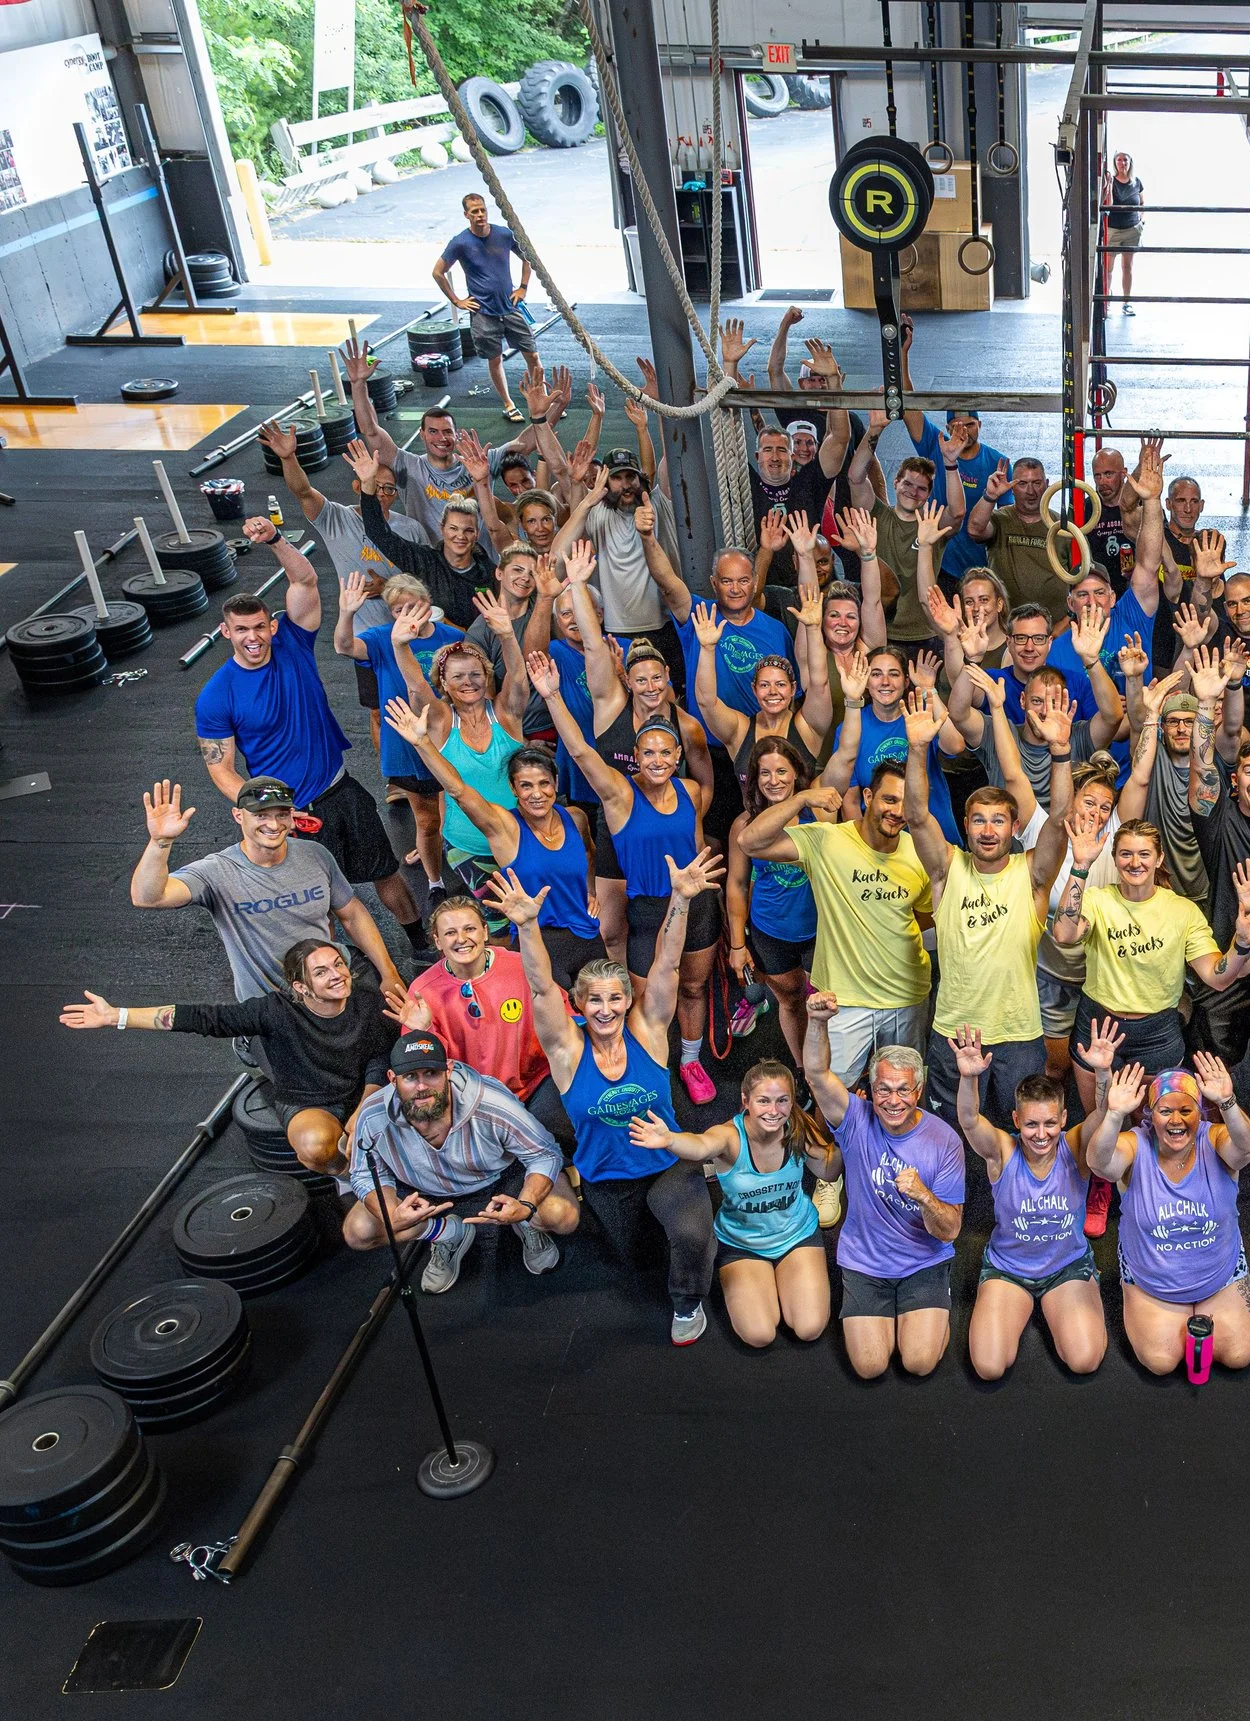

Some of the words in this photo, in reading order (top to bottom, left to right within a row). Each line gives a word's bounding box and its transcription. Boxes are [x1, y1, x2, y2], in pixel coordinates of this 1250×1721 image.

[767, 45, 790, 64] EXIT
[866, 189, 894, 215] R
[852, 869, 889, 883] Racks
[234, 885, 325, 915] ROGUE
[861, 889, 870, 901] &
[875, 886, 911, 901] Sacks
[961, 893, 992, 911] Racks
[967, 915, 977, 929] &
[980, 904, 1008, 926] Sacks
[1107, 923, 1142, 941] Racks
[1117, 945, 1127, 958] &
[1130, 936, 1164, 956] Sacks
[630, 1090, 658, 1108] AGES
[738, 1182, 785, 1200] CROSSFIT
[1020, 1199, 1036, 1214] ALL
[1037, 1196, 1069, 1211] CHALK
[1158, 1206, 1175, 1222] ALL
[1176, 1200, 1209, 1217] CHALK
[1015, 1231, 1031, 1242] NO
[1032, 1229, 1073, 1242] ACTION
[1156, 1243, 1173, 1252] NO
[1176, 1235, 1216, 1251] ACTION
